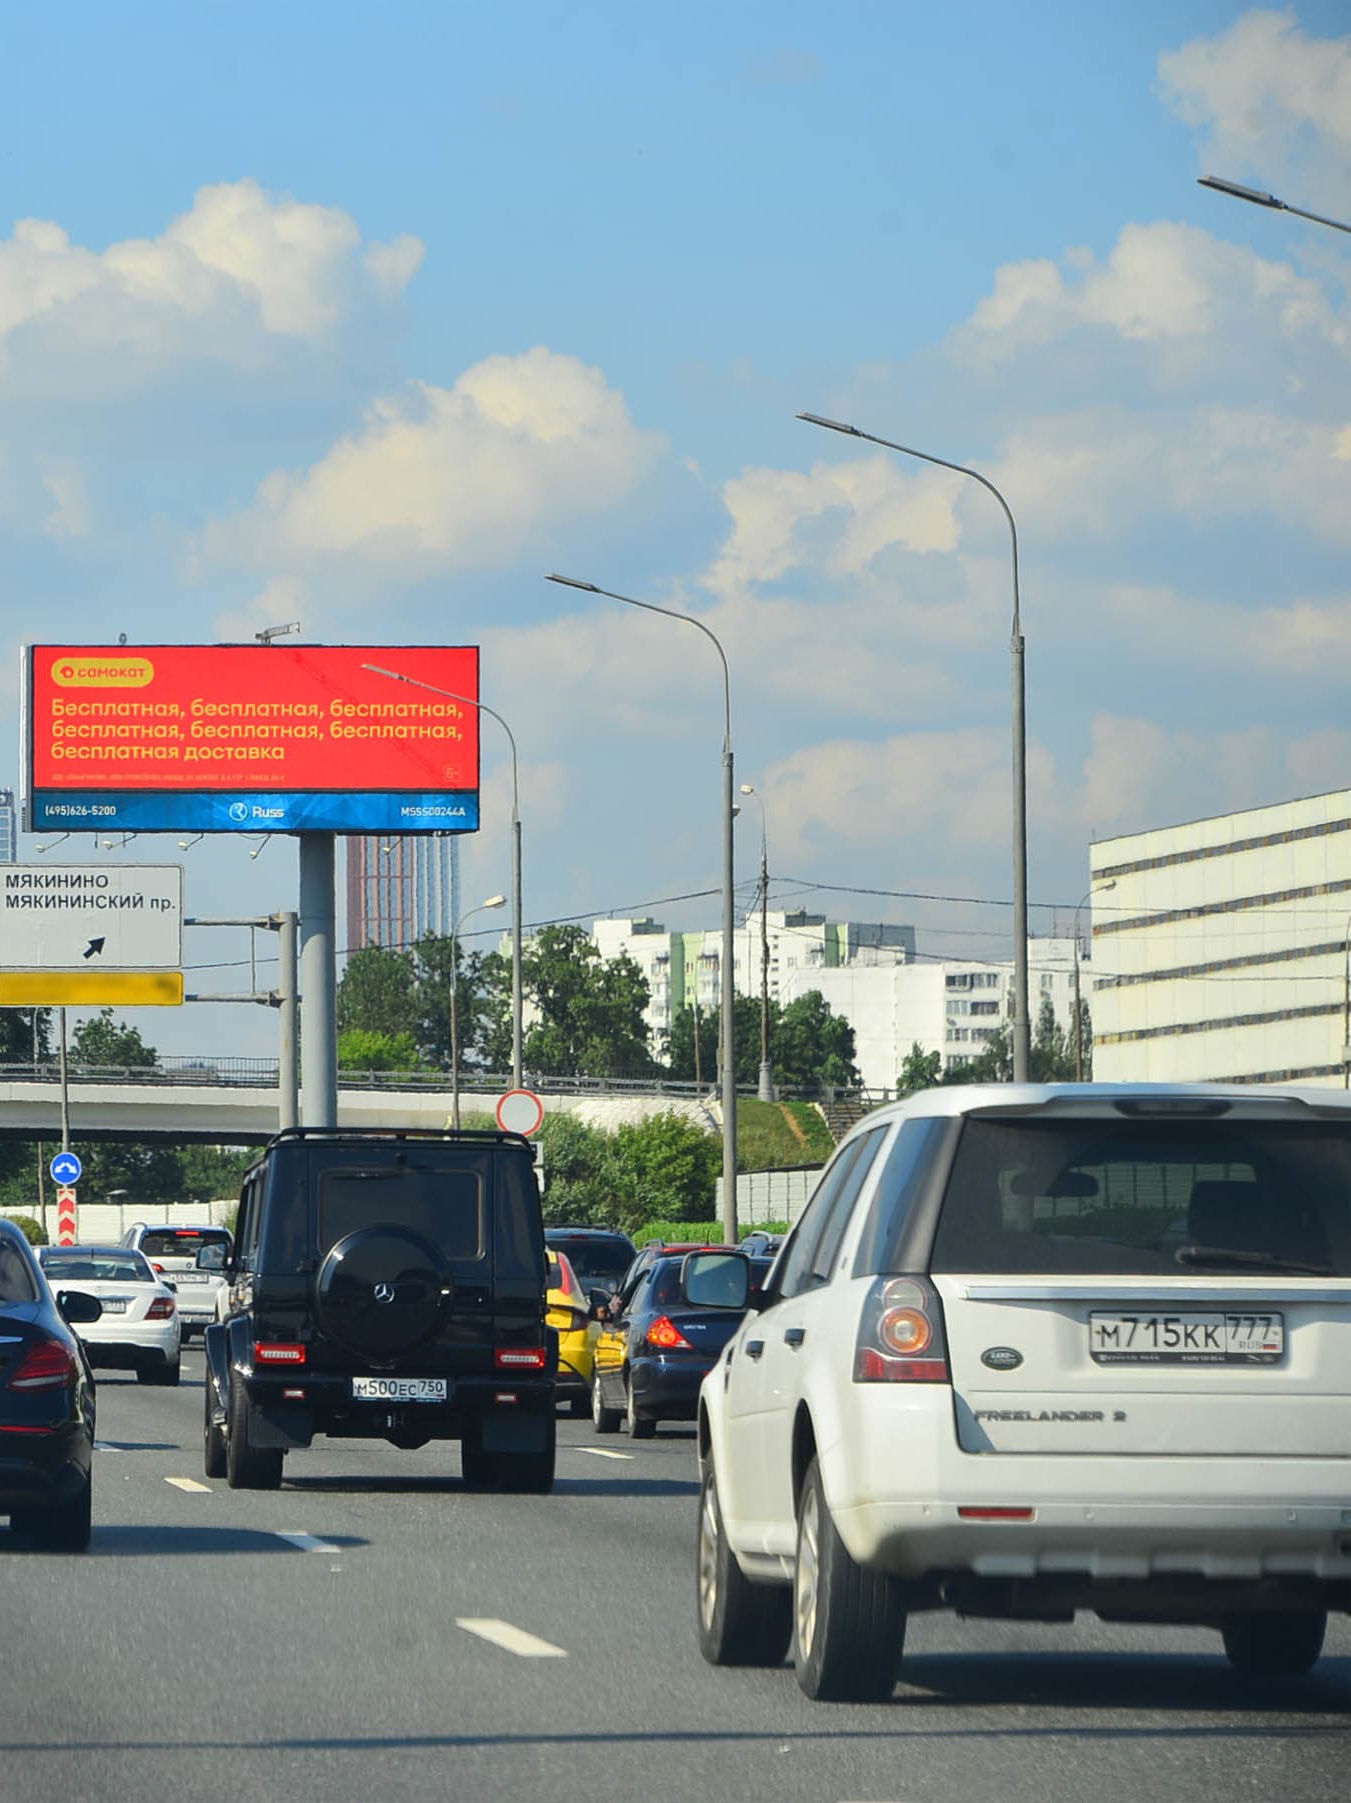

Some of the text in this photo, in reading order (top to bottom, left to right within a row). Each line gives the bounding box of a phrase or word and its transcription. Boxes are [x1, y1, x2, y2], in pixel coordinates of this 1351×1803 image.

[77, 666, 146, 679] самокат
[51, 698, 464, 719] Бесплатная, бесплатная, бесплатная,
[51, 720, 463, 741] бесплатная, бесплатная, бесплатная,
[50, 741, 285, 761] бесплатная доставка
[44, 805, 117, 817] (495)626-5200
[252, 806, 285, 818] Russ
[5, 874, 109, 889] МЯКИНИНО
[5, 892, 176, 912] МЯКИНИНСКИЙ пр.
[1100, 1316, 1273, 1348] М715КК 777
[1239, 1341, 1263, 1349] RUS
[357, 1380, 443, 1396] М500ЕС 750
[974, 1410, 1104, 1423] FREELANDER
